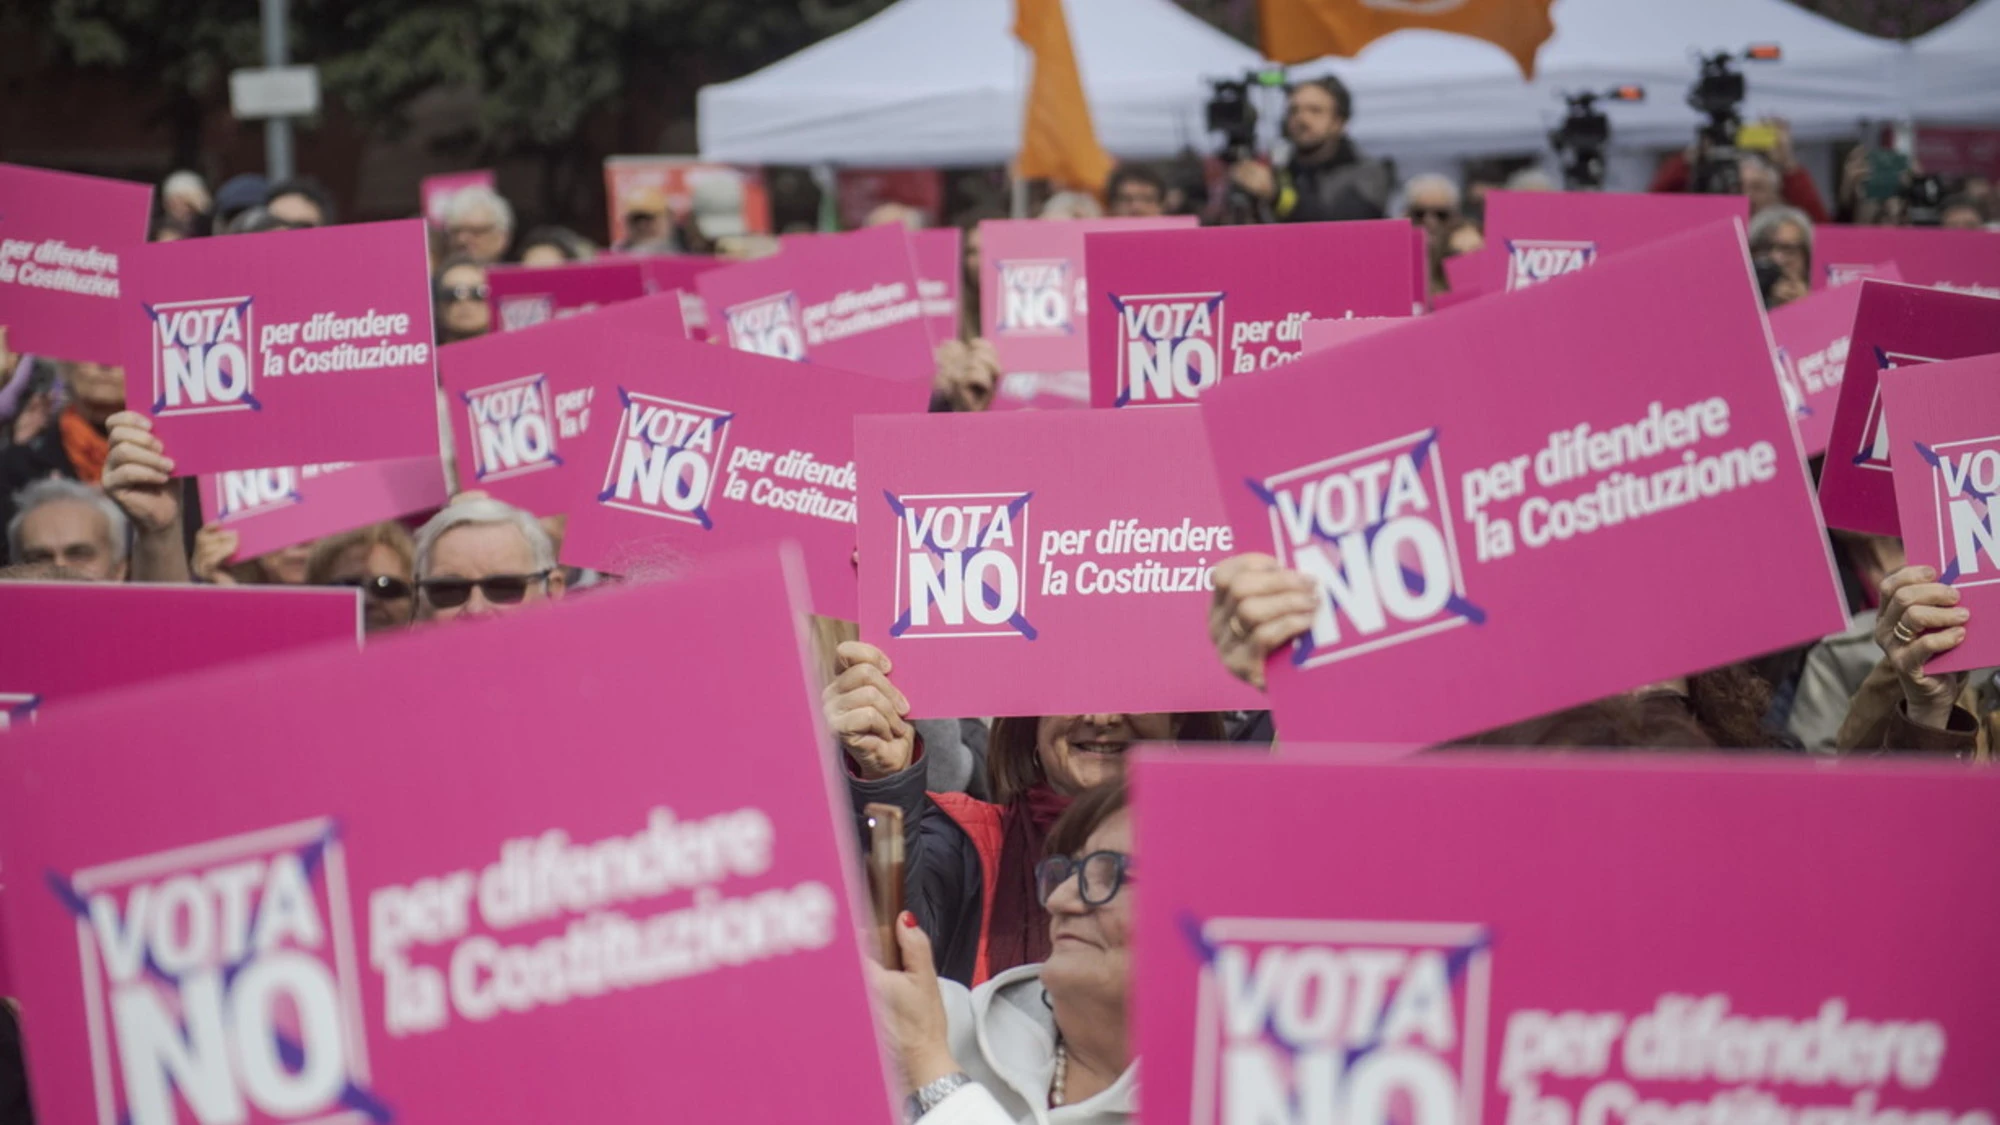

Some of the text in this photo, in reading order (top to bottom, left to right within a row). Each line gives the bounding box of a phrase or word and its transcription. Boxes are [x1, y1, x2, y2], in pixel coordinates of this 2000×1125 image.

[157, 307, 242, 347] VOTA
[260, 309, 409, 353] per difendere
[1005, 288, 1067, 328] NO
[1123, 302, 1213, 339] VOTA
[1230, 321, 1271, 350] per
[162, 342, 248, 406] NO
[262, 340, 428, 377] la Costituzione
[1127, 337, 1217, 400] NO
[1232, 346, 1256, 374] la
[470, 384, 541, 425] VOTA
[627, 402, 715, 453] VOTA
[478, 413, 549, 473] NO
[726, 445, 776, 473] per
[1461, 396, 1730, 522] per difendere
[615, 438, 709, 511] NO
[722, 469, 748, 501] la
[1275, 453, 1429, 546] VOTA
[1474, 439, 1777, 562] la Costituzione
[905, 505, 1014, 549] VOTA
[1039, 518, 1234, 564] per difendere
[909, 550, 1019, 626] NO
[1041, 562, 1068, 596] la
[1294, 515, 1453, 648] NO
[90, 850, 324, 982] VOTA
[369, 804, 776, 972] per difendere
[384, 880, 838, 1038] la Costituzione
[1212, 945, 1458, 1050] VOTA
[109, 948, 348, 1125] NO
[1497, 993, 1947, 1094] per difendere
